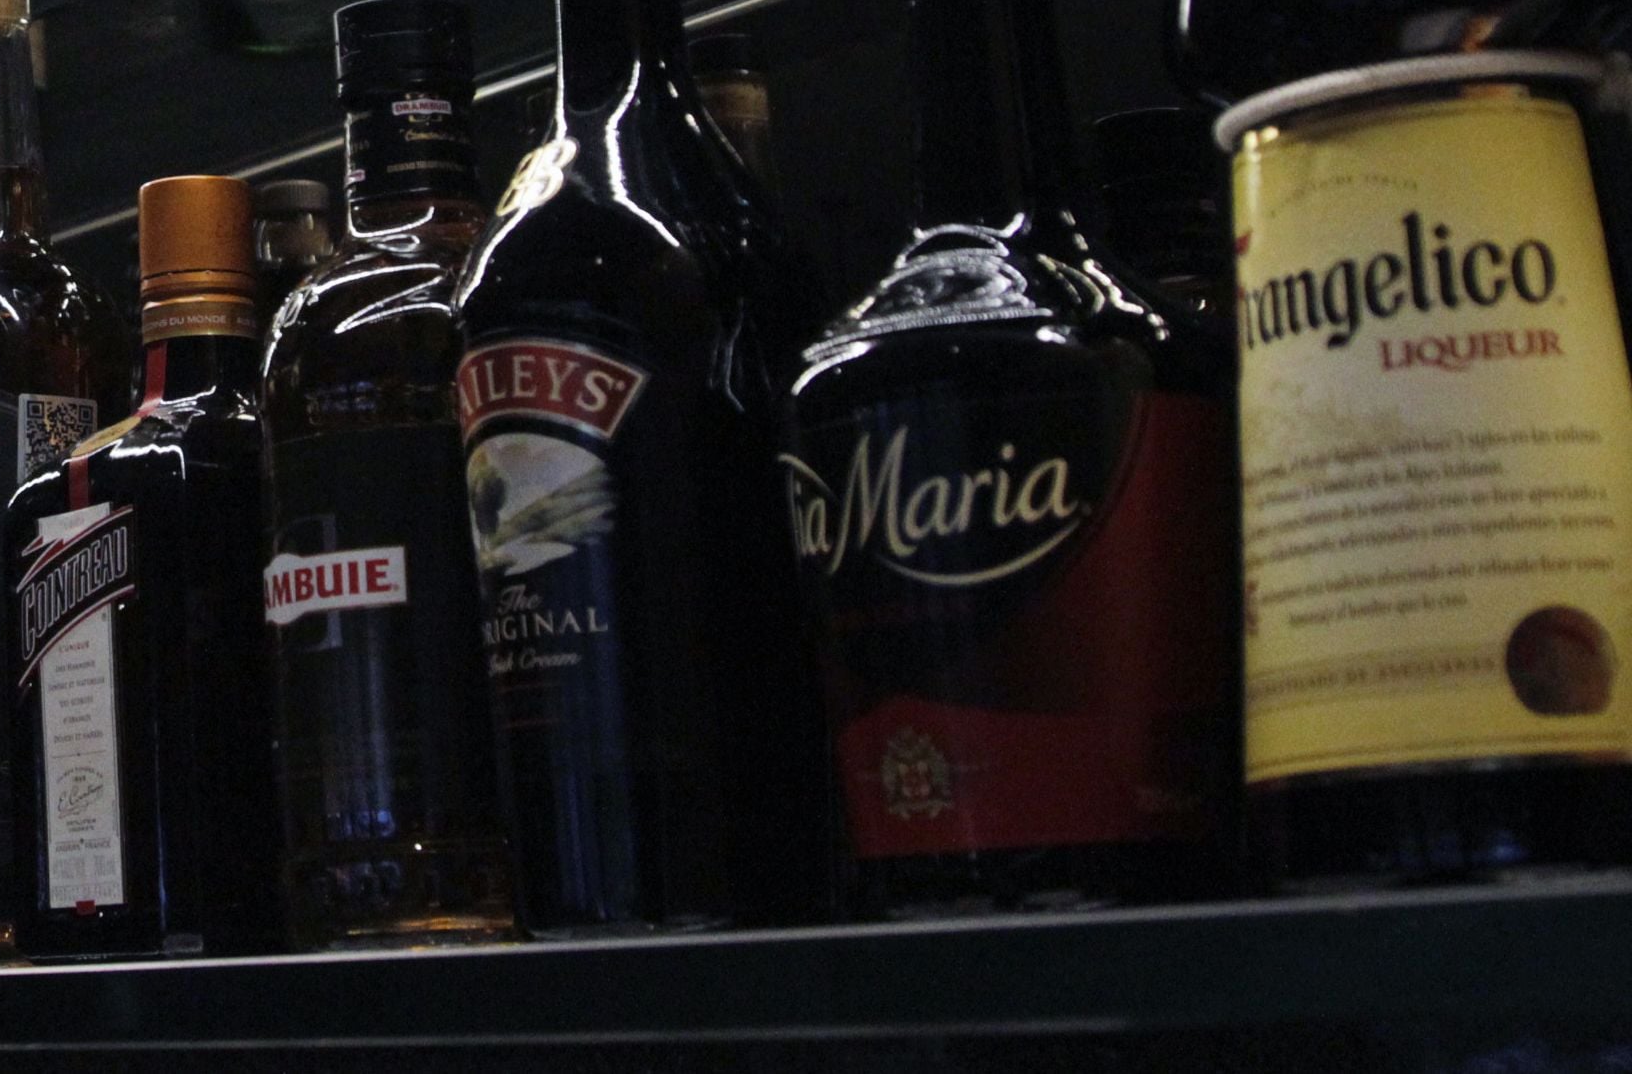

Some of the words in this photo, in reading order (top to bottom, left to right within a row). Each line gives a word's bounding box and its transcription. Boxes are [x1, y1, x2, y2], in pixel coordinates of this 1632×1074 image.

[1241, 210, 1558, 349] rangelico
[1379, 327, 1565, 373] LIQUEUR
[829, 425, 1080, 575] Maria
[21, 526, 128, 661] COINTREAU
